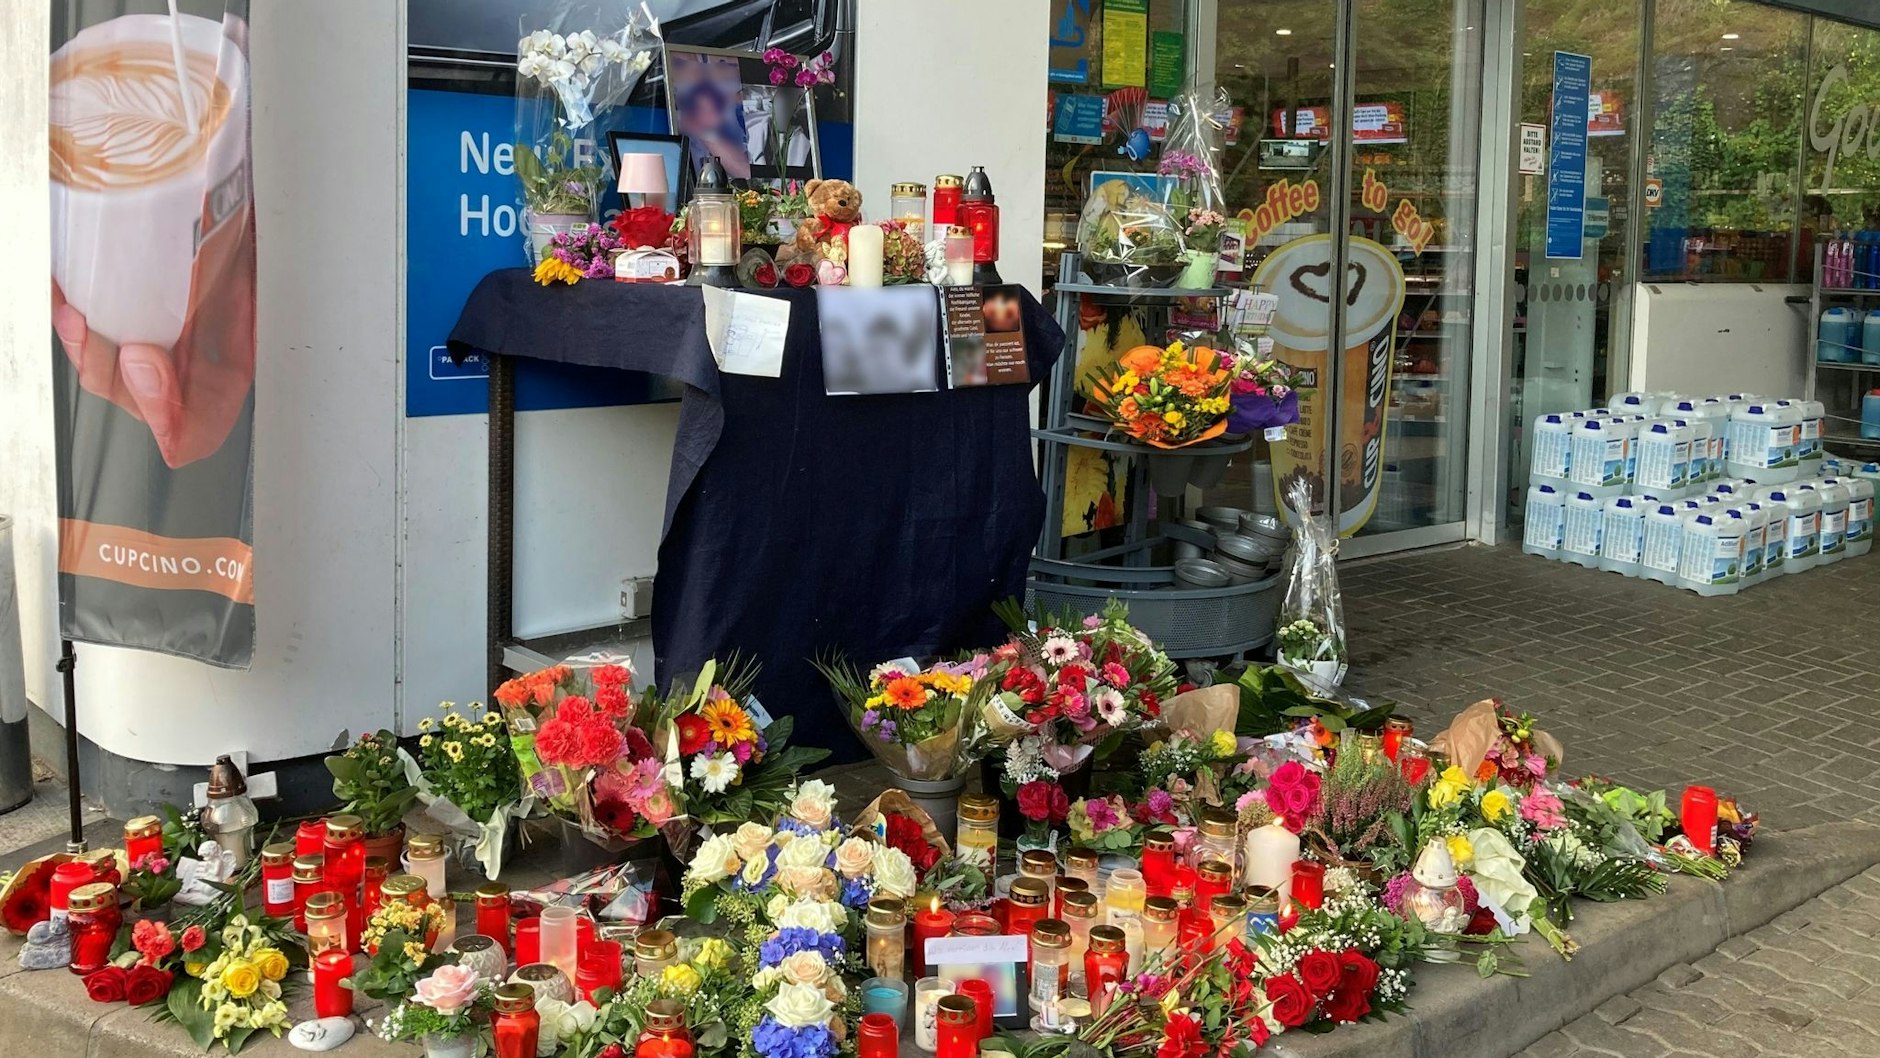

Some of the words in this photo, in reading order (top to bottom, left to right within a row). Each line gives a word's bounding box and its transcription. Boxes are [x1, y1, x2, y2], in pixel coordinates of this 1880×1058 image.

[1646, 188, 1659, 197] DKV
[1238, 178, 1319, 250] Coffee
[1362, 168, 1387, 213] to
[1392, 198, 1434, 257] go!
[1245, 299, 1276, 311] HAPPY
[441, 355, 479, 364] PAACK
[1370, 335, 1389, 408] CINO
